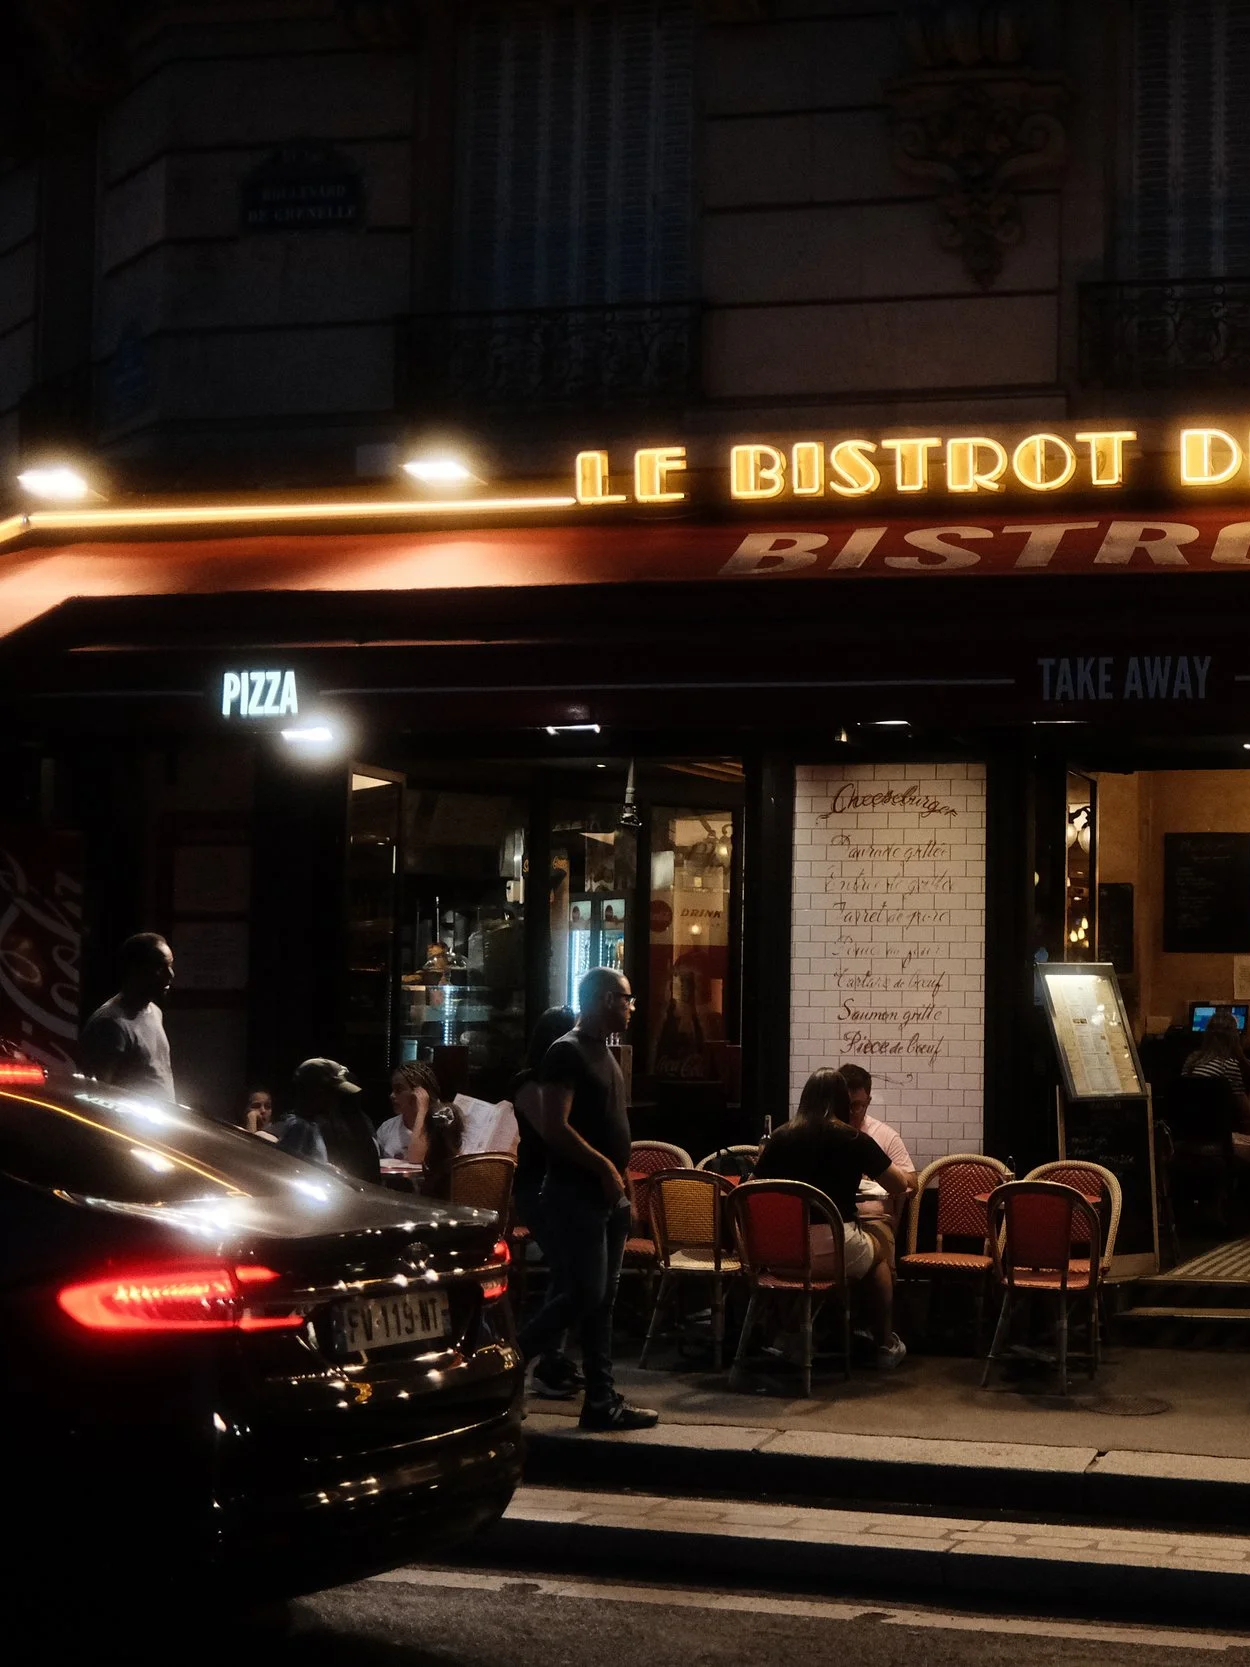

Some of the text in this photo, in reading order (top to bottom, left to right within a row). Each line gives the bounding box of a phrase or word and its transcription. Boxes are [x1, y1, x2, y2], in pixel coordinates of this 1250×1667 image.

[576, 446, 687, 505] LE
[731, 431, 1137, 498] BISTROT
[222, 670, 299, 717] PIZZA
[1037, 655, 1212, 701] TAKE AWAY
[816, 783, 958, 825] Cheeseburger
[680, 907, 721, 919] DRINK
[837, 998, 898, 1021] Saumon
[889, 1041, 904, 1055] de
